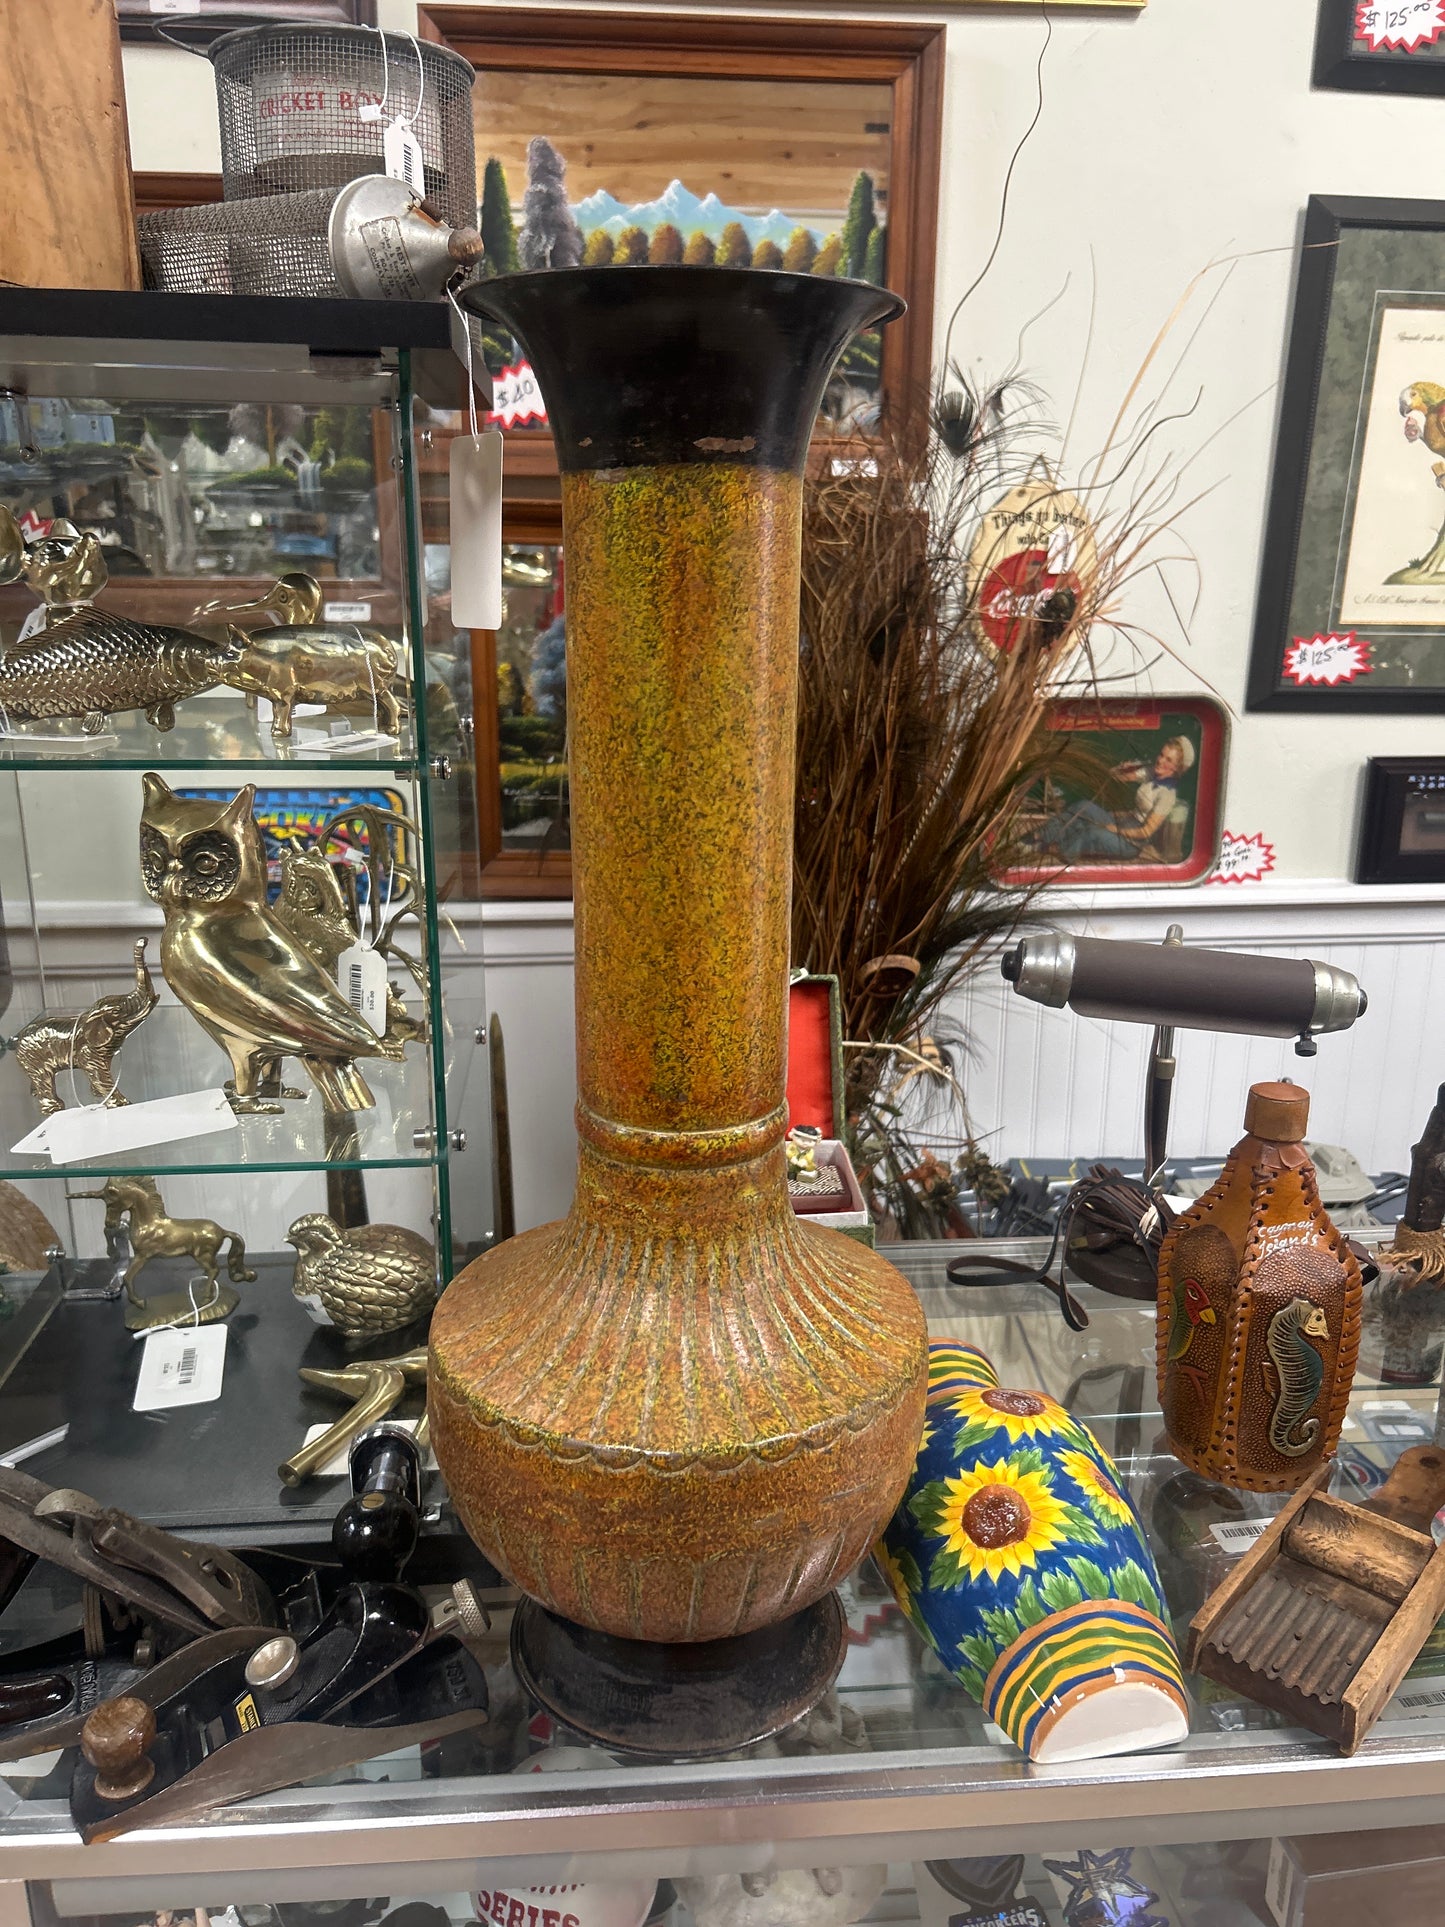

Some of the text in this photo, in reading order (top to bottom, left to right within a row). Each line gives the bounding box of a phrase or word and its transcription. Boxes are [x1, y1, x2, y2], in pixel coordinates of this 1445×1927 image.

[260, 91, 326, 119] CRICKET
[1257, 1221, 1314, 1239] Cayman
[1256, 1231, 1319, 1260] Islands
[245, 1704, 259, 1730] STANLE
[961, 1908, 1040, 1927] FORCERS
